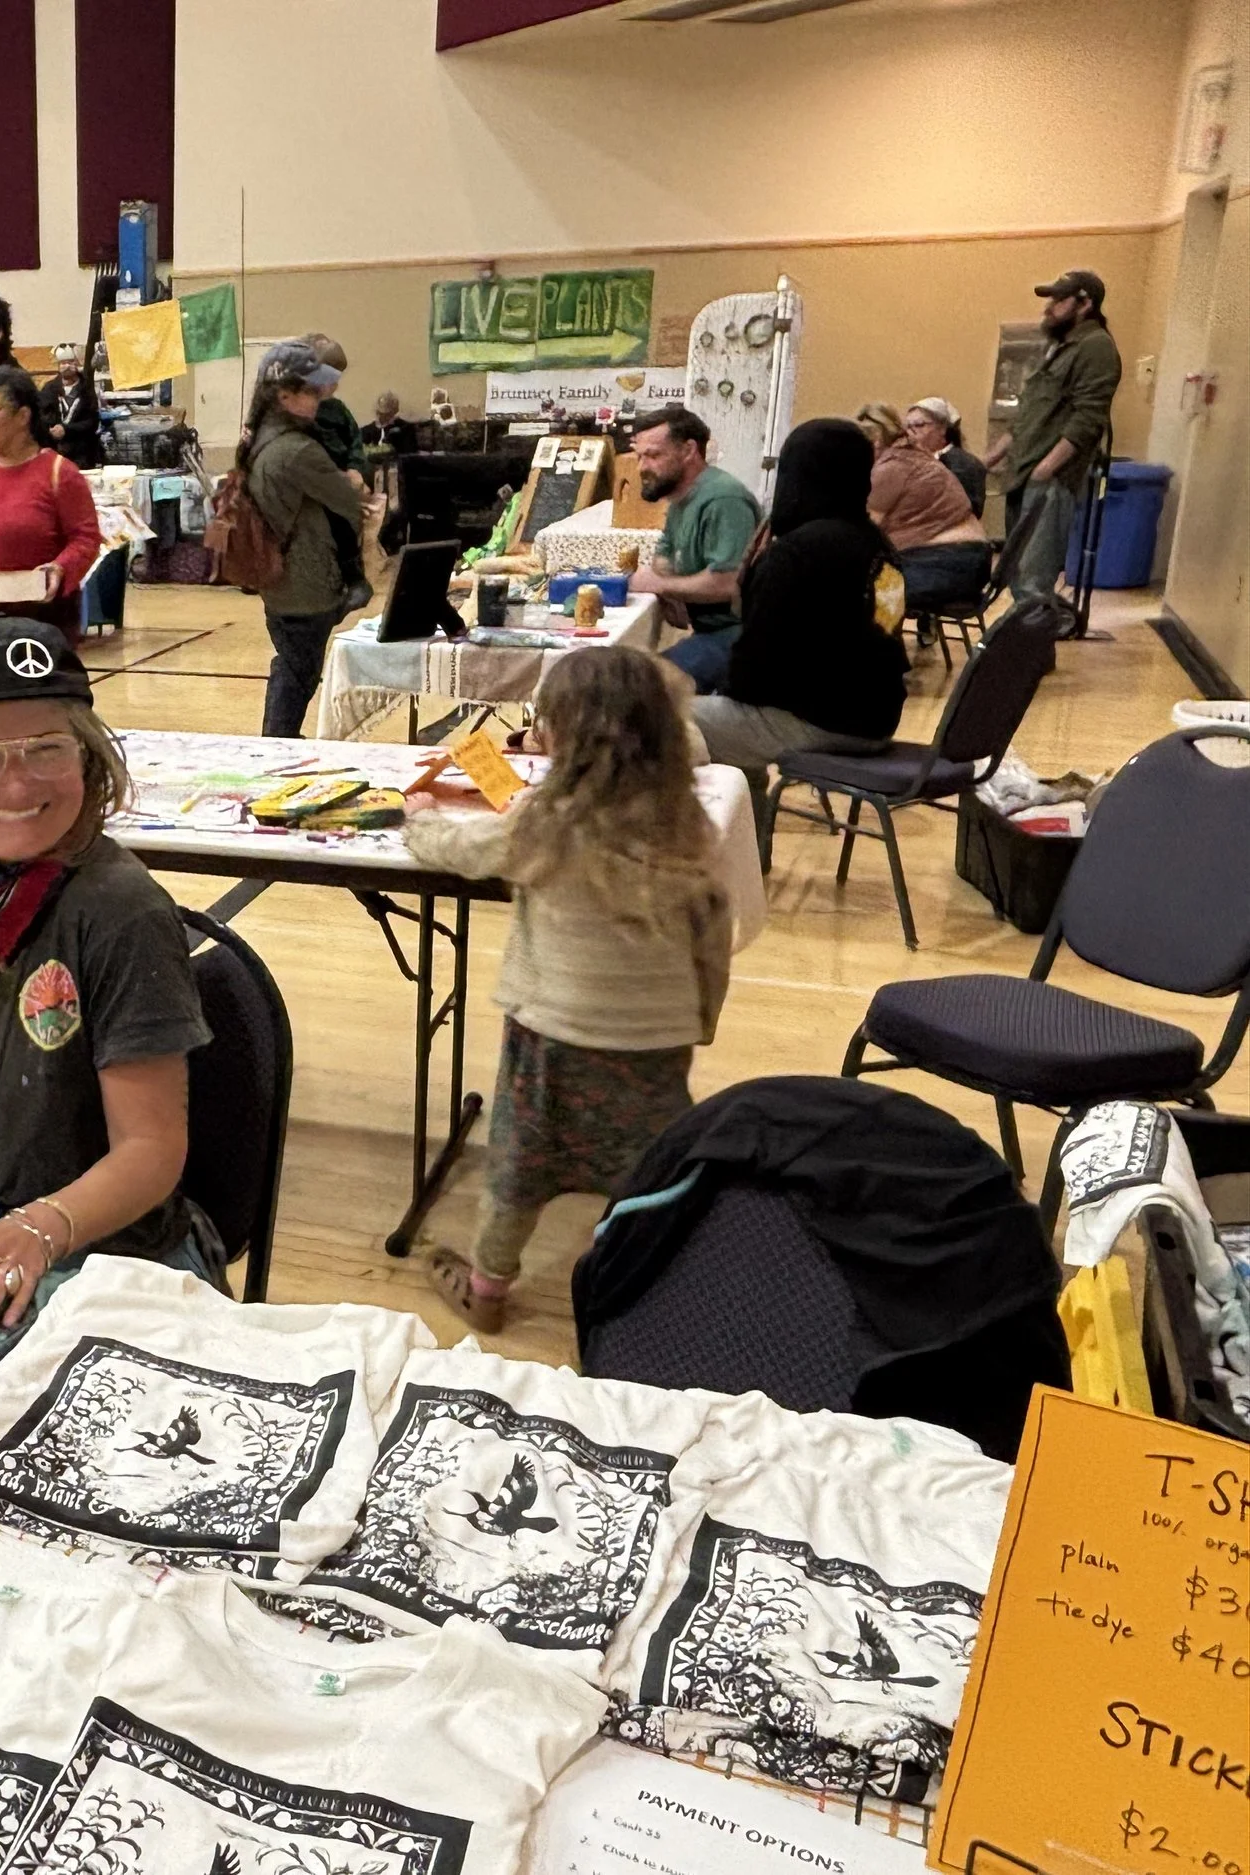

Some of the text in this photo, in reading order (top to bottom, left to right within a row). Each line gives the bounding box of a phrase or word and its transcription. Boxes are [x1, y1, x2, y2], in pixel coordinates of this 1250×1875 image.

[433, 277, 649, 339] LIVE PLANTS
[558, 384, 610, 401] Family
[30, 1474, 87, 1510] Plant
[356, 1562, 418, 1598] Plant
[1060, 1539, 1250, 1622] plain $3
[1099, 1701, 1250, 1800] STICK
[637, 1789, 846, 1874] PAYMENT OPTIONS
[1118, 1799, 1241, 1875] $2.00
